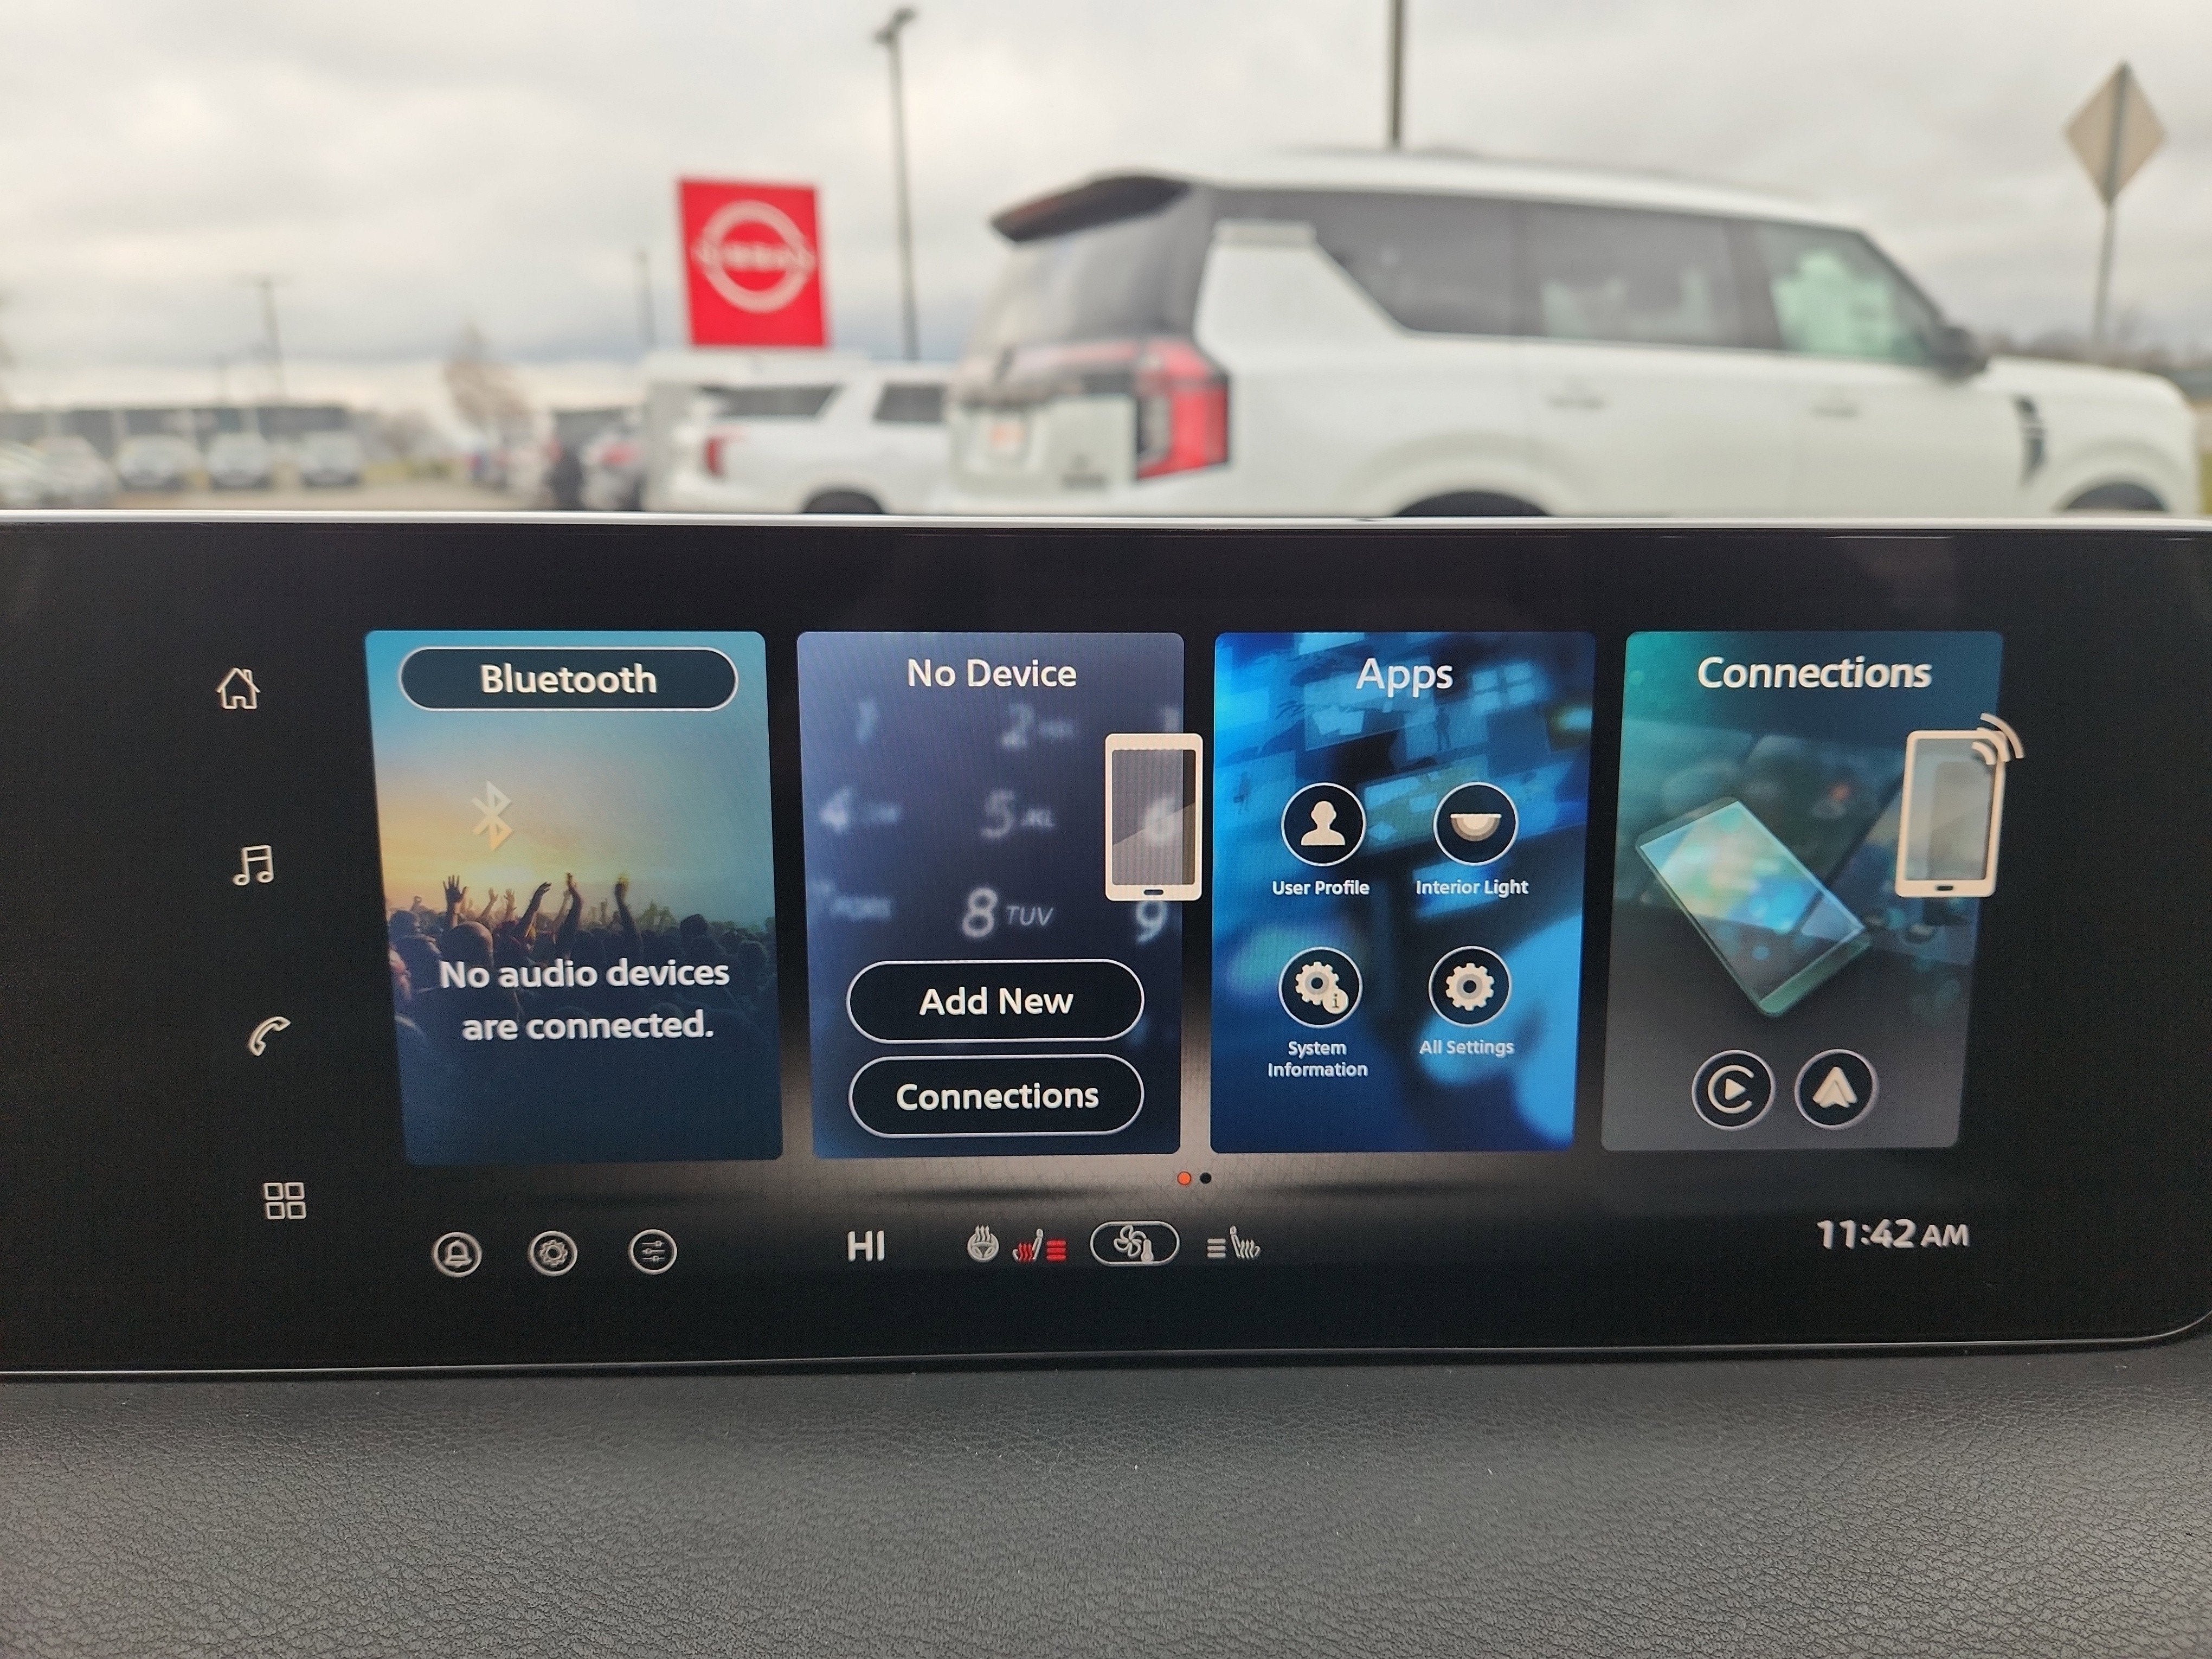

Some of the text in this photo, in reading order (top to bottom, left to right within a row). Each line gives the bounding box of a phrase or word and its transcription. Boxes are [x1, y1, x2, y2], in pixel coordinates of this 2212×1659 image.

[481, 663, 657, 693] Bluetooth
[907, 658, 1077, 687] No Device
[1355, 657, 1454, 698] Apps
[1697, 655, 1933, 689] Connections
[1272, 878, 1370, 896] User Profile
[1416, 878, 1529, 898] Interior Light
[962, 887, 1053, 938] 8 TUV
[1135, 900, 1168, 943] 9
[439, 958, 730, 988] No audio devices
[919, 987, 1074, 1015] Add New
[462, 1009, 714, 1041] are connected.
[1288, 1041, 1347, 1059] System
[1419, 1039, 1515, 1058] All Settings
[1268, 1062, 1368, 1077] Information
[896, 1083, 1099, 1110] Connections
[847, 1231, 885, 1262] HI
[1817, 1219, 1969, 1249] 11:42 AM
